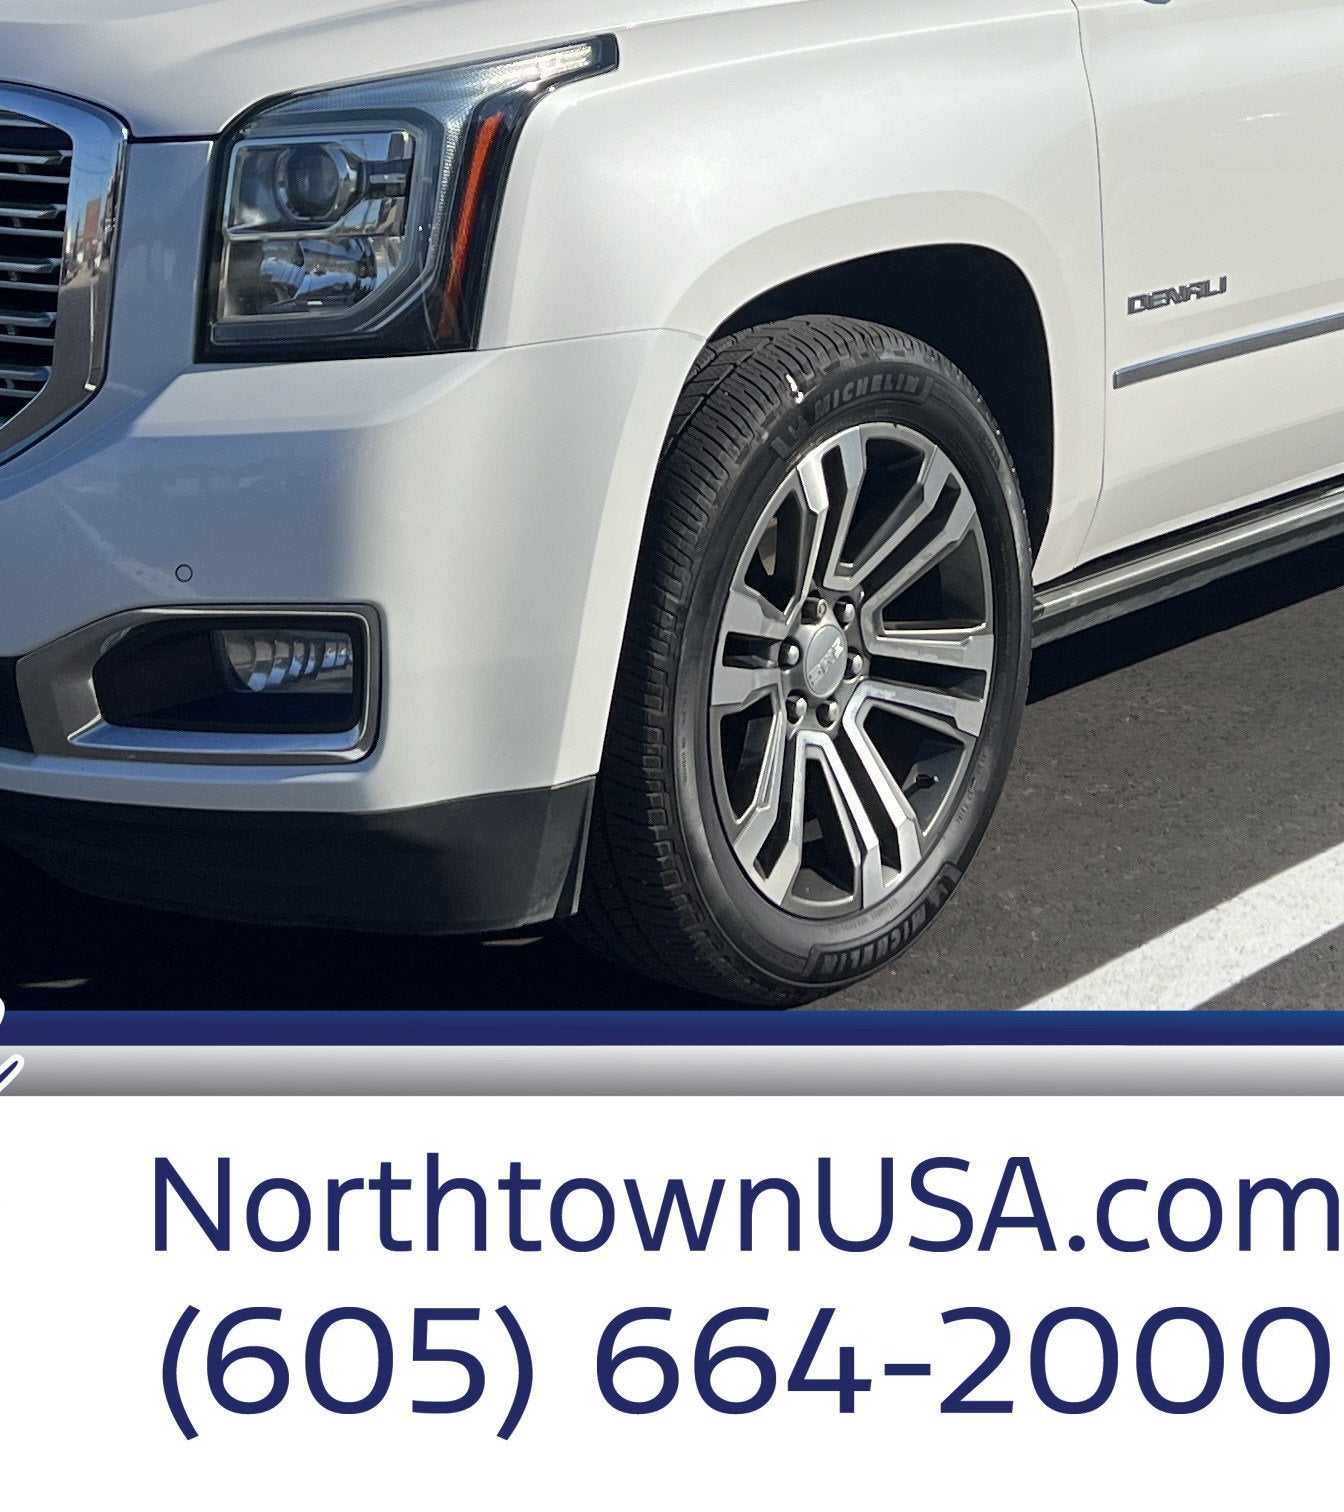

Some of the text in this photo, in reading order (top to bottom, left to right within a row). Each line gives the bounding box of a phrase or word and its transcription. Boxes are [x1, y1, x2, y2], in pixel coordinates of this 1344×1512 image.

[1126, 276, 1227, 315] DENALI
[814, 373, 921, 422] MICHELIN
[819, 902, 927, 975] MICHELIN
